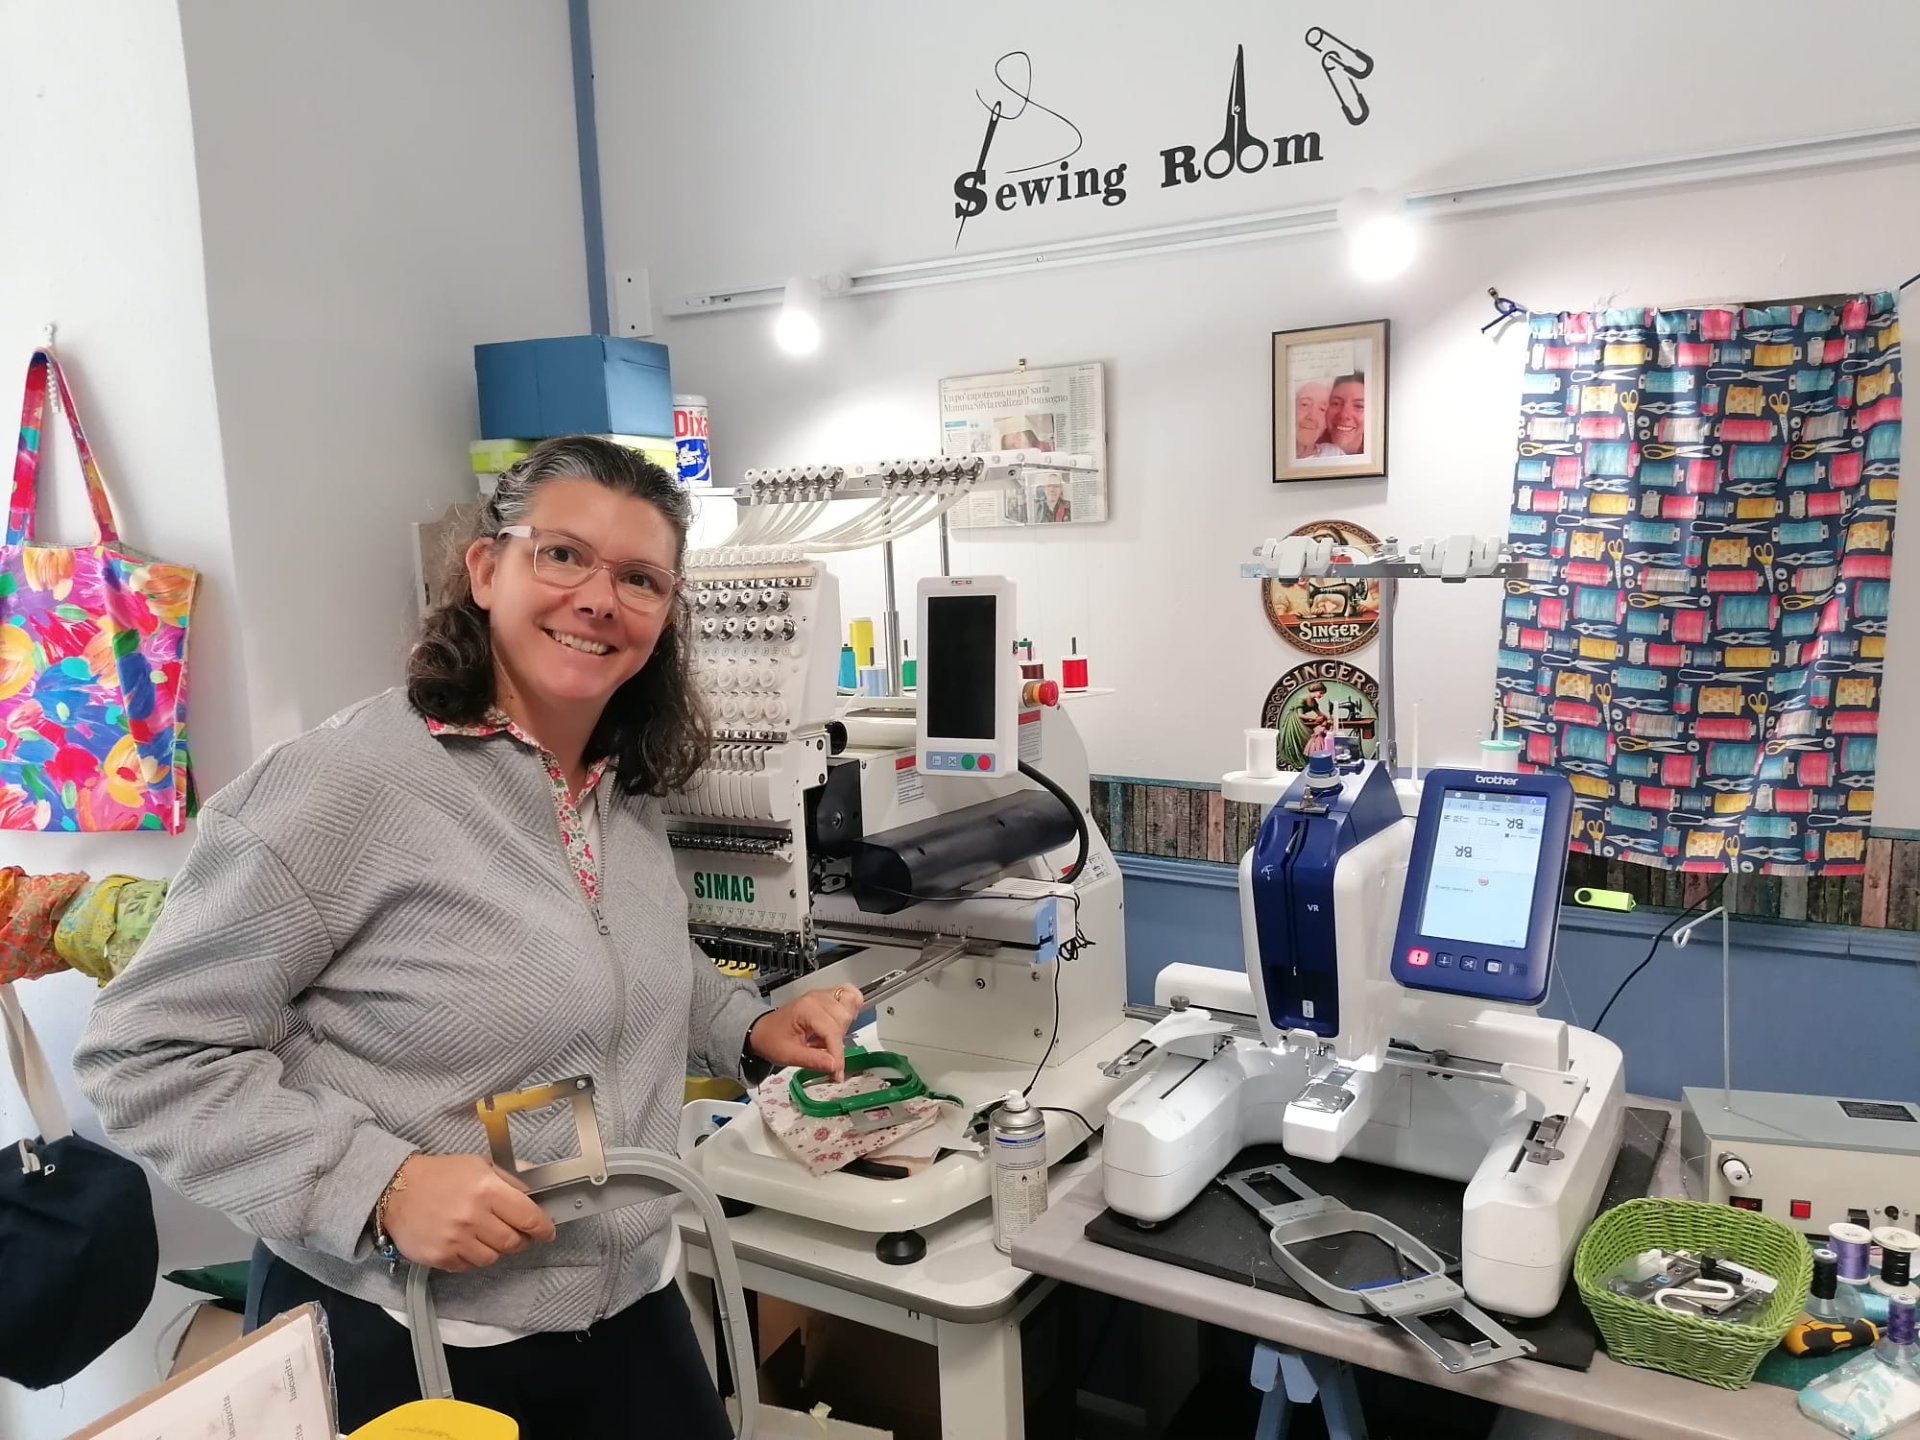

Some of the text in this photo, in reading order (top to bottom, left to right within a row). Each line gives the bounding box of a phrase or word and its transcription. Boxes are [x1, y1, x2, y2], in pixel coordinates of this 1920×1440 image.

[953, 161, 1128, 219] Sewing
[1299, 621, 1363, 640] SINGER
[1282, 662, 1366, 690] SINGER
[1475, 774, 1519, 787] brother
[694, 871, 755, 903] SIMAC
[1307, 903, 1319, 912] VR
